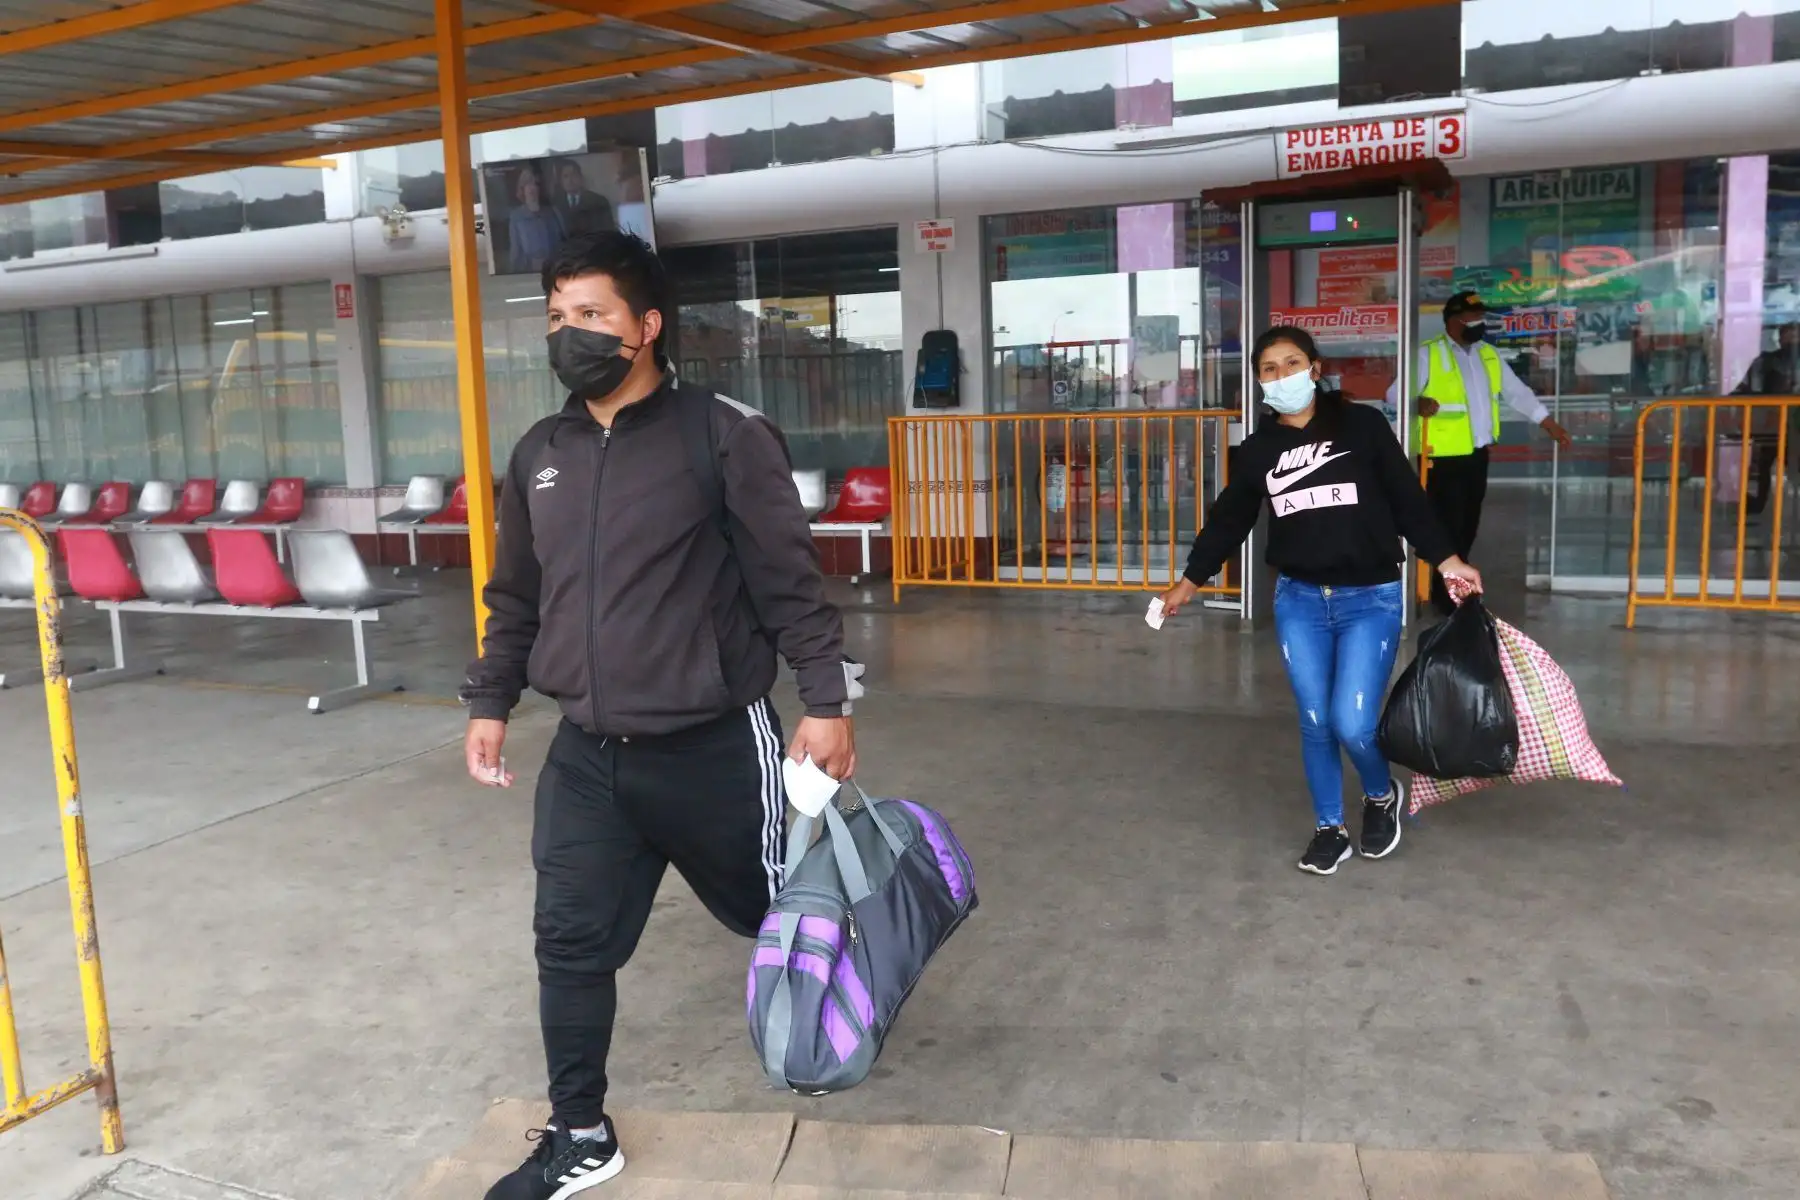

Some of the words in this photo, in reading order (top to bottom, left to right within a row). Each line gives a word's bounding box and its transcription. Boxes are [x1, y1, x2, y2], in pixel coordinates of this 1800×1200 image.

[1287, 121, 1384, 149] PUERTA
[1393, 117, 1426, 139] DE
[1438, 118, 1461, 155] 3
[1287, 141, 1426, 173] EMBARQUE
[1275, 440, 1334, 474] NIKE
[1283, 487, 1342, 512] AIR
